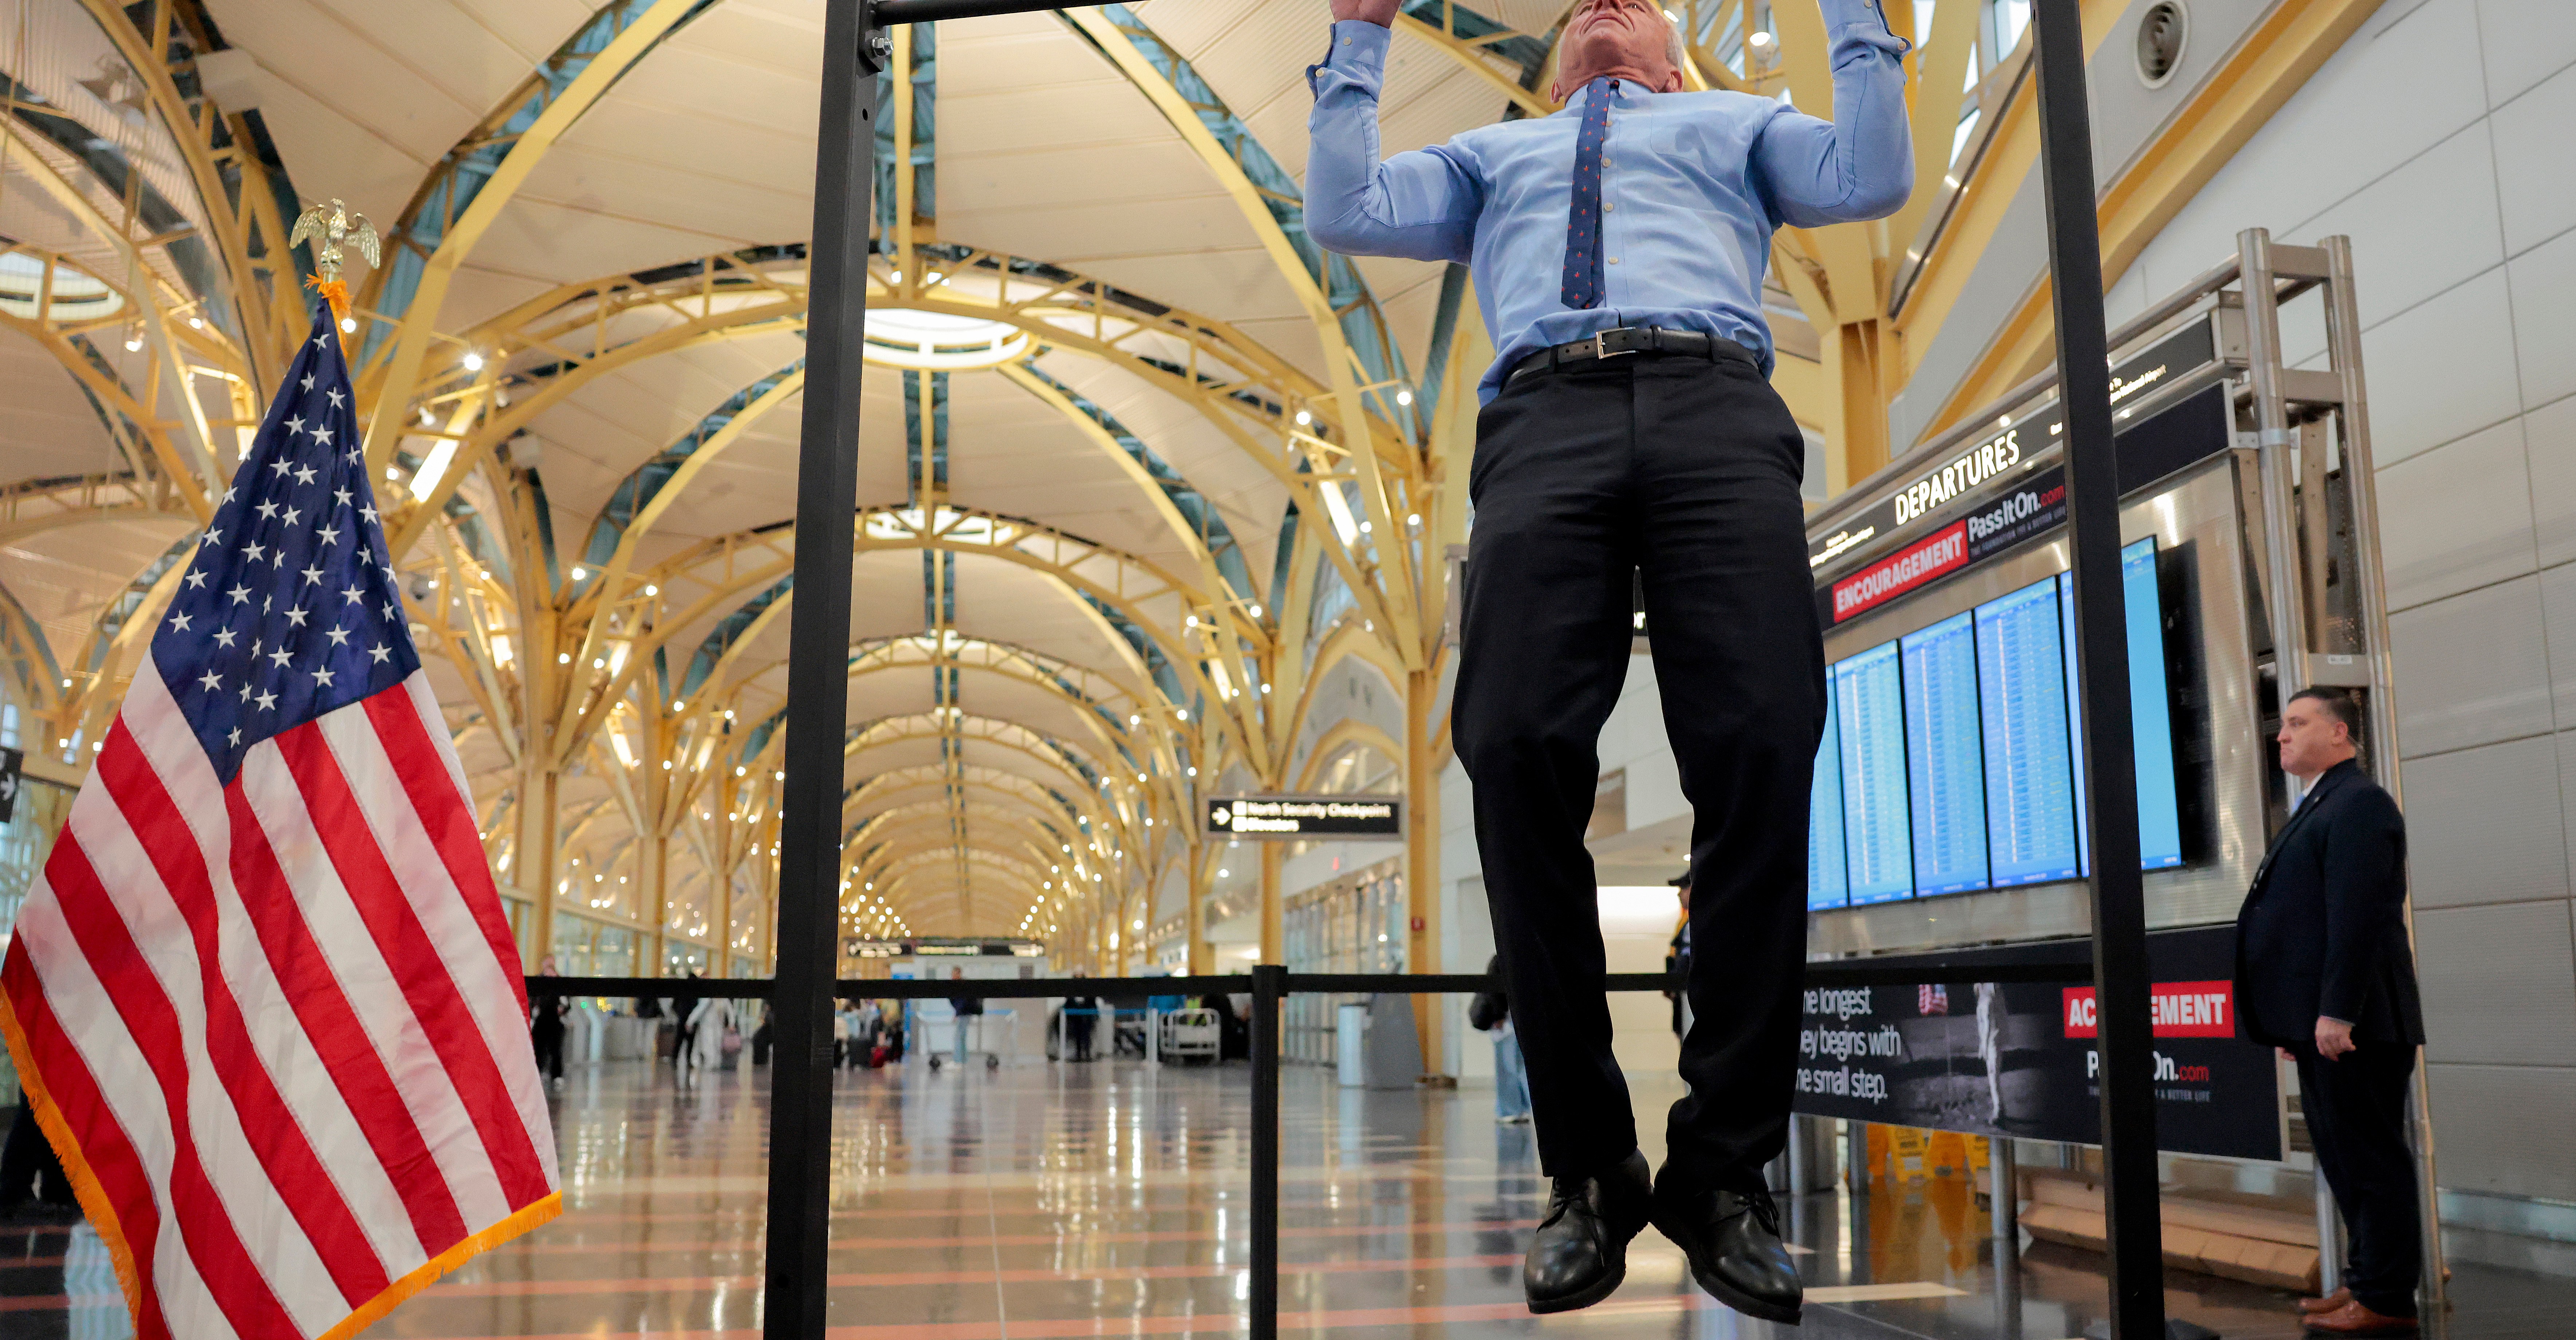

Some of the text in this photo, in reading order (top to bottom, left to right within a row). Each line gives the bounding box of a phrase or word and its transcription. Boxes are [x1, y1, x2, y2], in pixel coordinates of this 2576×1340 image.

[1895, 429, 2020, 526] DEPARTURES
[1968, 485, 2065, 542] PassItOn.com
[1836, 531, 1963, 613] ENCOURAGEMENT
[1819, 987, 1872, 1021] longest
[1819, 1024, 1867, 1062] begins
[1867, 1024, 1902, 1057] with
[1813, 1065, 1850, 1096] small
[1851, 1067, 1888, 1105] step.
